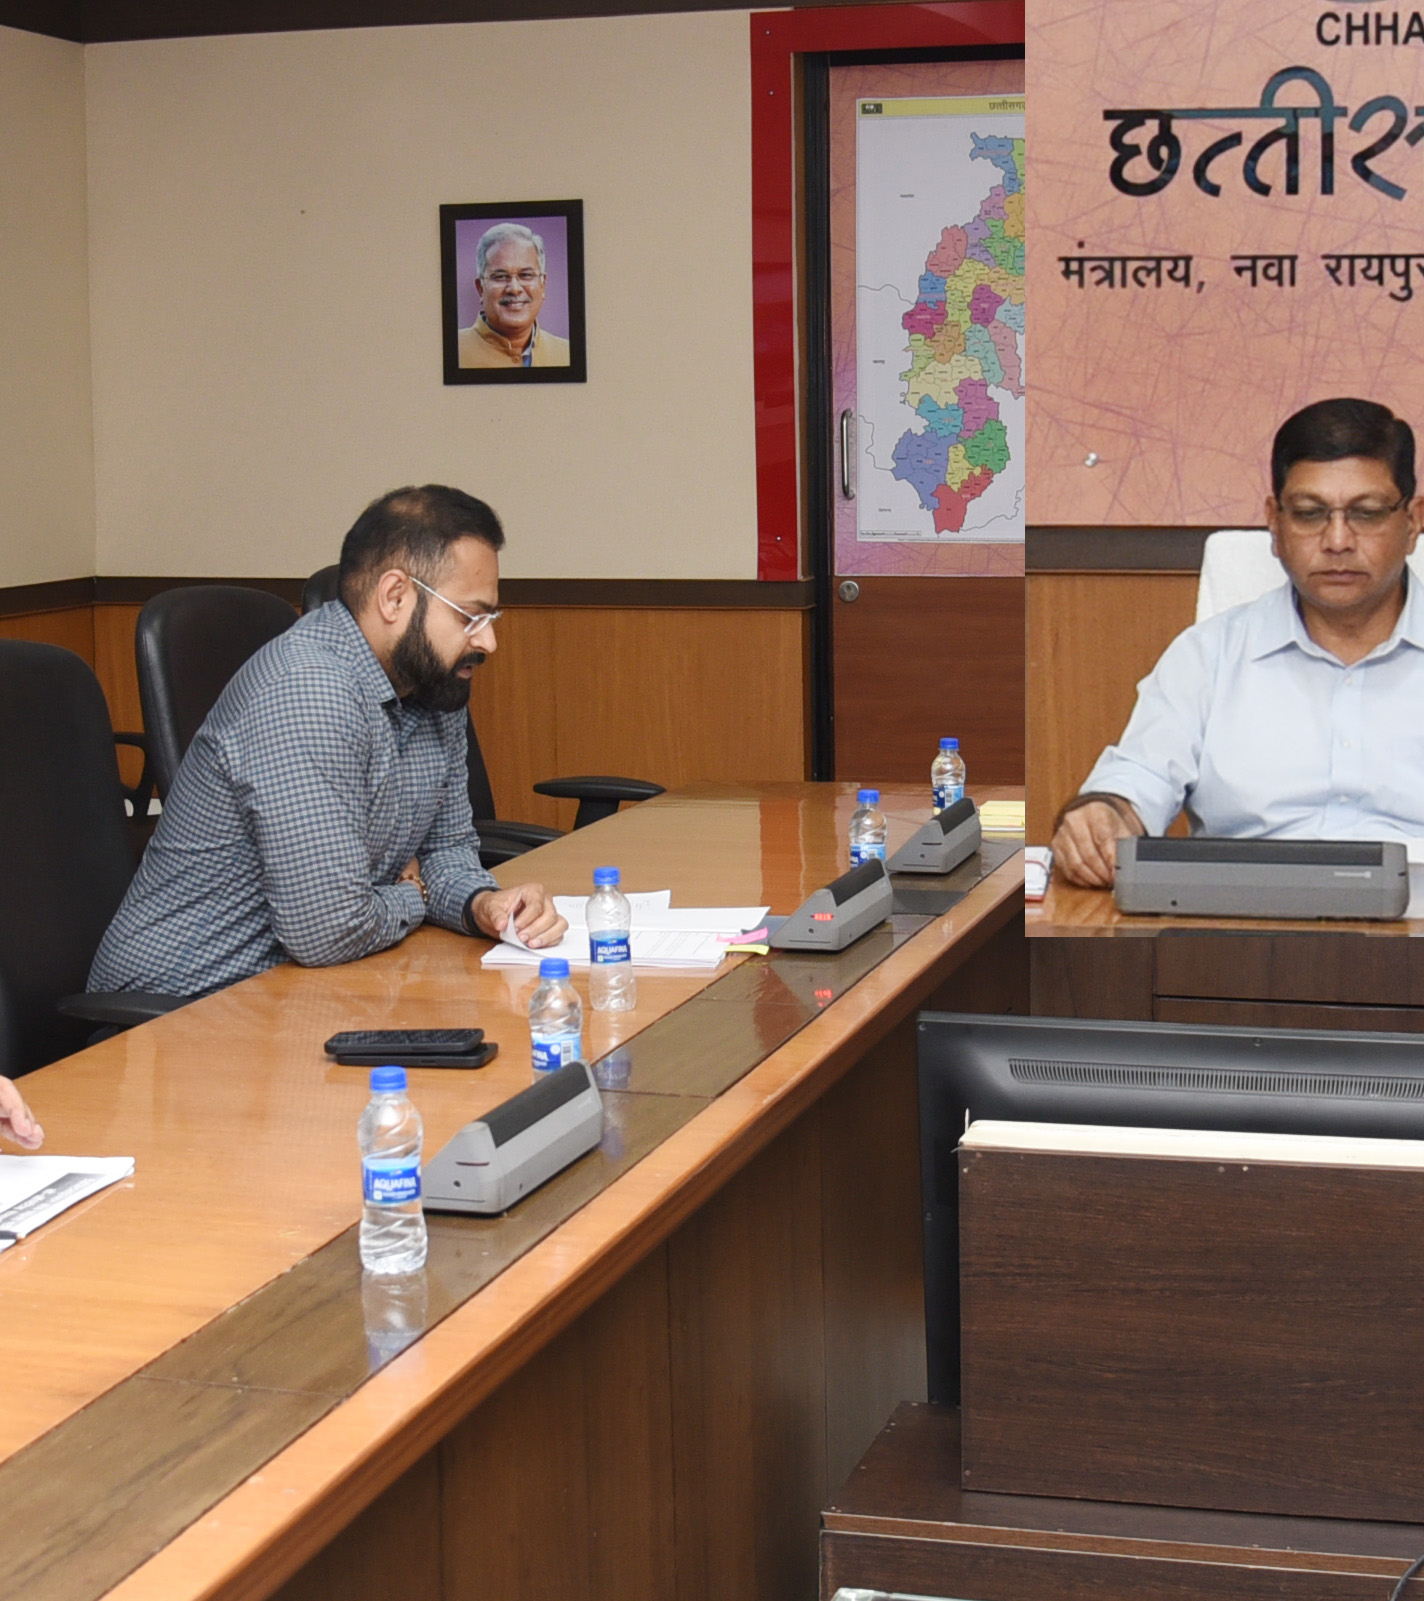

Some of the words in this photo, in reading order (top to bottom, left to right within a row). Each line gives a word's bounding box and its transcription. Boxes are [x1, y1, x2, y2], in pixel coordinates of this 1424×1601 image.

[1058, 240, 1205, 295] मंत्रालय,
[1231, 254, 1299, 288] नवा
[597, 944, 628, 956] AQUAFINA
[373, 1176, 418, 1192] AQUAFINA
